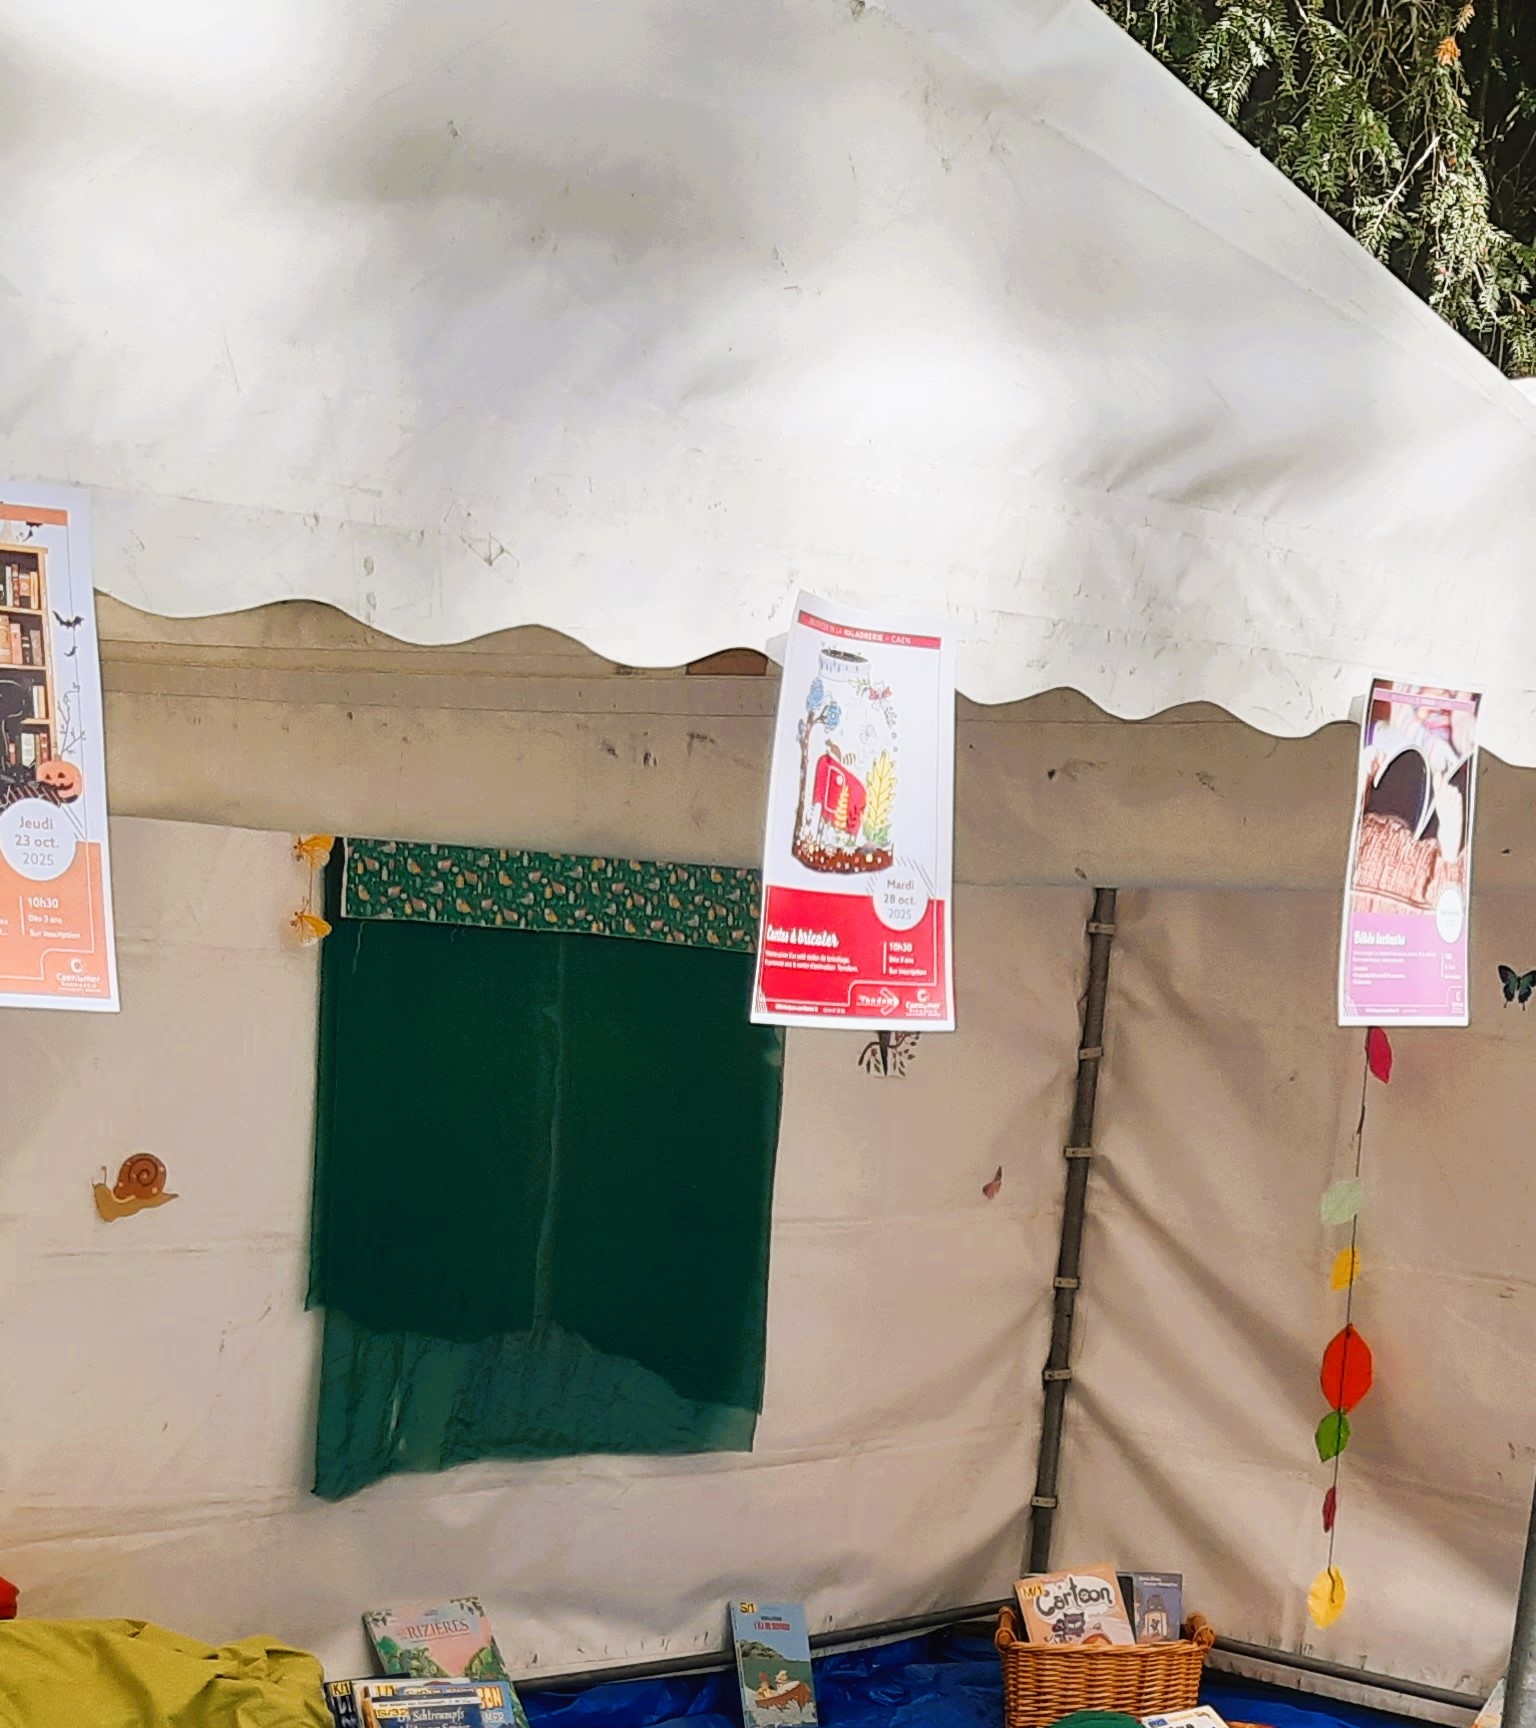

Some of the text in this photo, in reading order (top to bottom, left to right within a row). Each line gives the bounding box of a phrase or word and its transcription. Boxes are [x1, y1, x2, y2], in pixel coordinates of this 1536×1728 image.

[19, 816, 54, 830] Jeudi
[14, 834, 60, 849] 23 oct.
[22, 853, 54, 866] 2025
[887, 879, 914, 890] Mardi
[27, 897, 59, 908] 10h30
[884, 894, 917, 905] 28 oct.
[888, 909, 912, 919] 2025
[1036, 1575, 1113, 1616] Cartoon
[407, 1618, 469, 1639] RIZIÈRES
